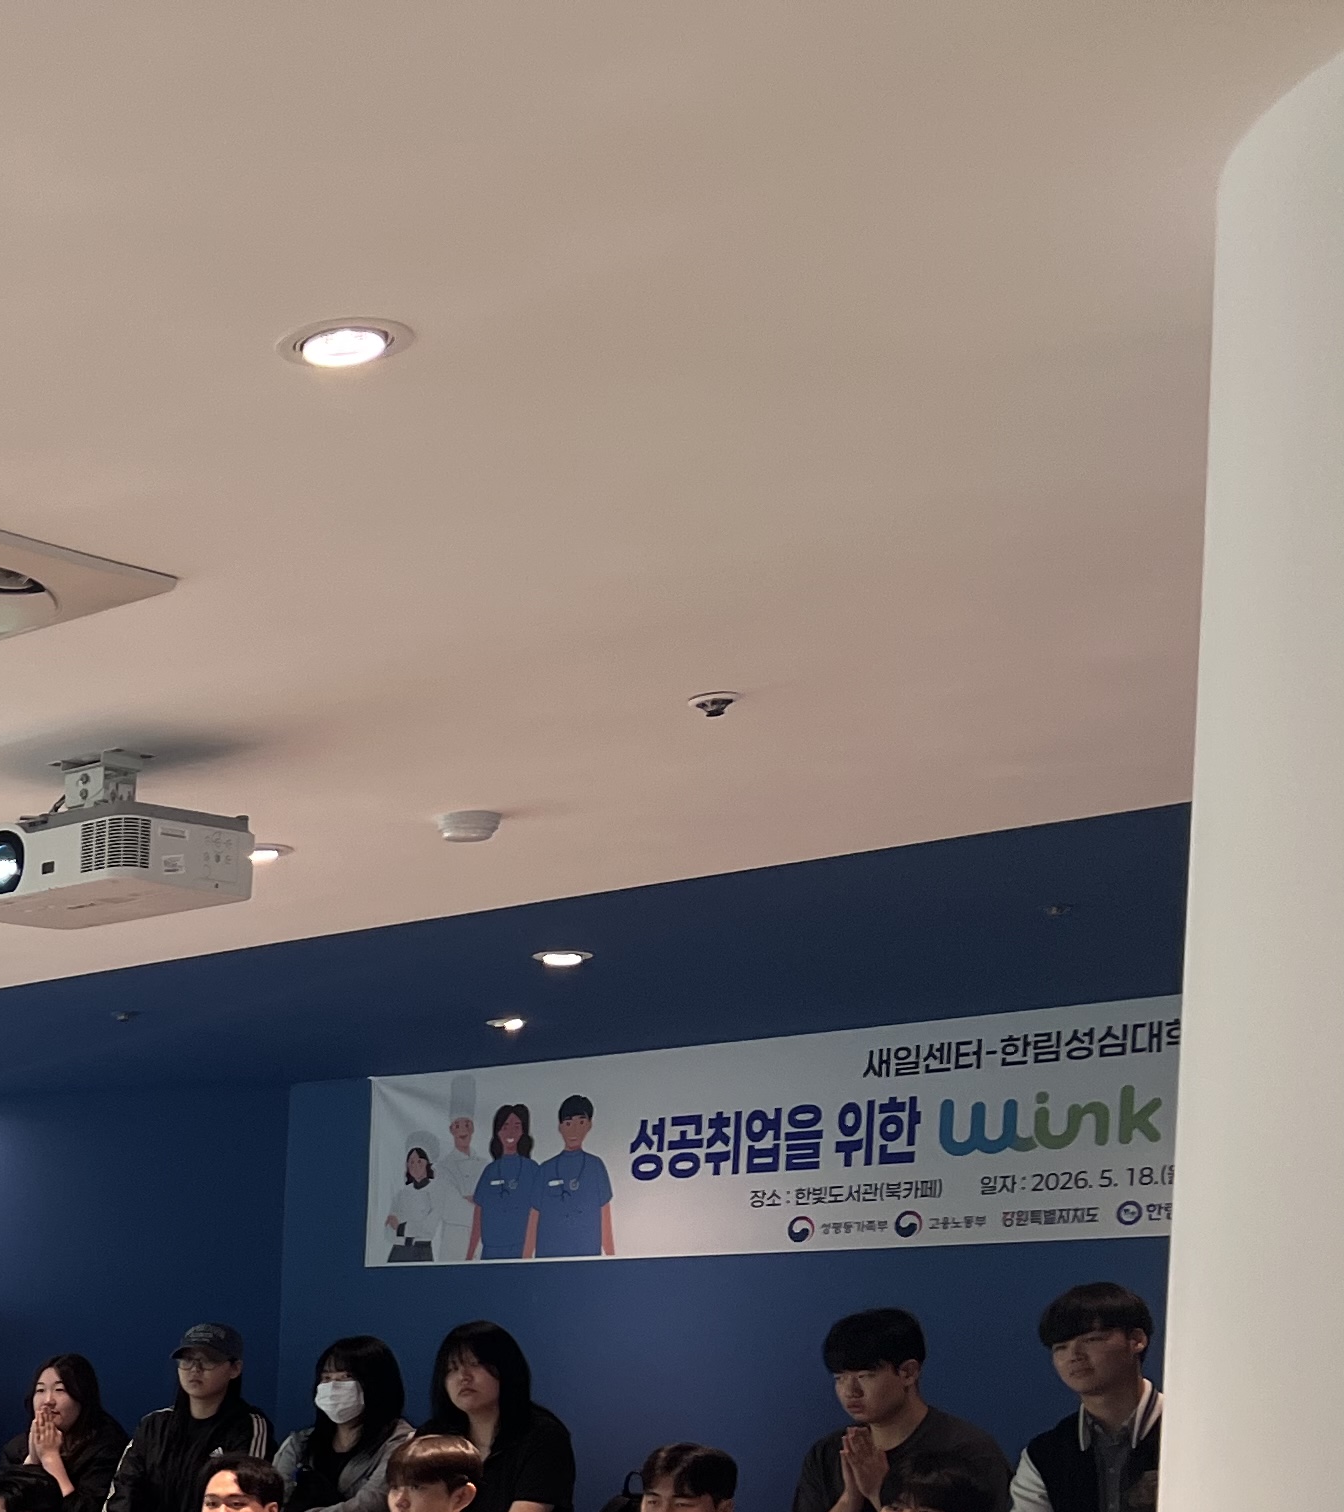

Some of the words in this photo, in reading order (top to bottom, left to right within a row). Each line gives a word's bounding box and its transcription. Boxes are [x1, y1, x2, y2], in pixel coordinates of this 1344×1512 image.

[630, 1104, 823, 1181] 성공취업을
[835, 1096, 921, 1167] 위한
[1031, 1170, 1093, 1191] 2026.
[1099, 1168, 1119, 1187] 5.
